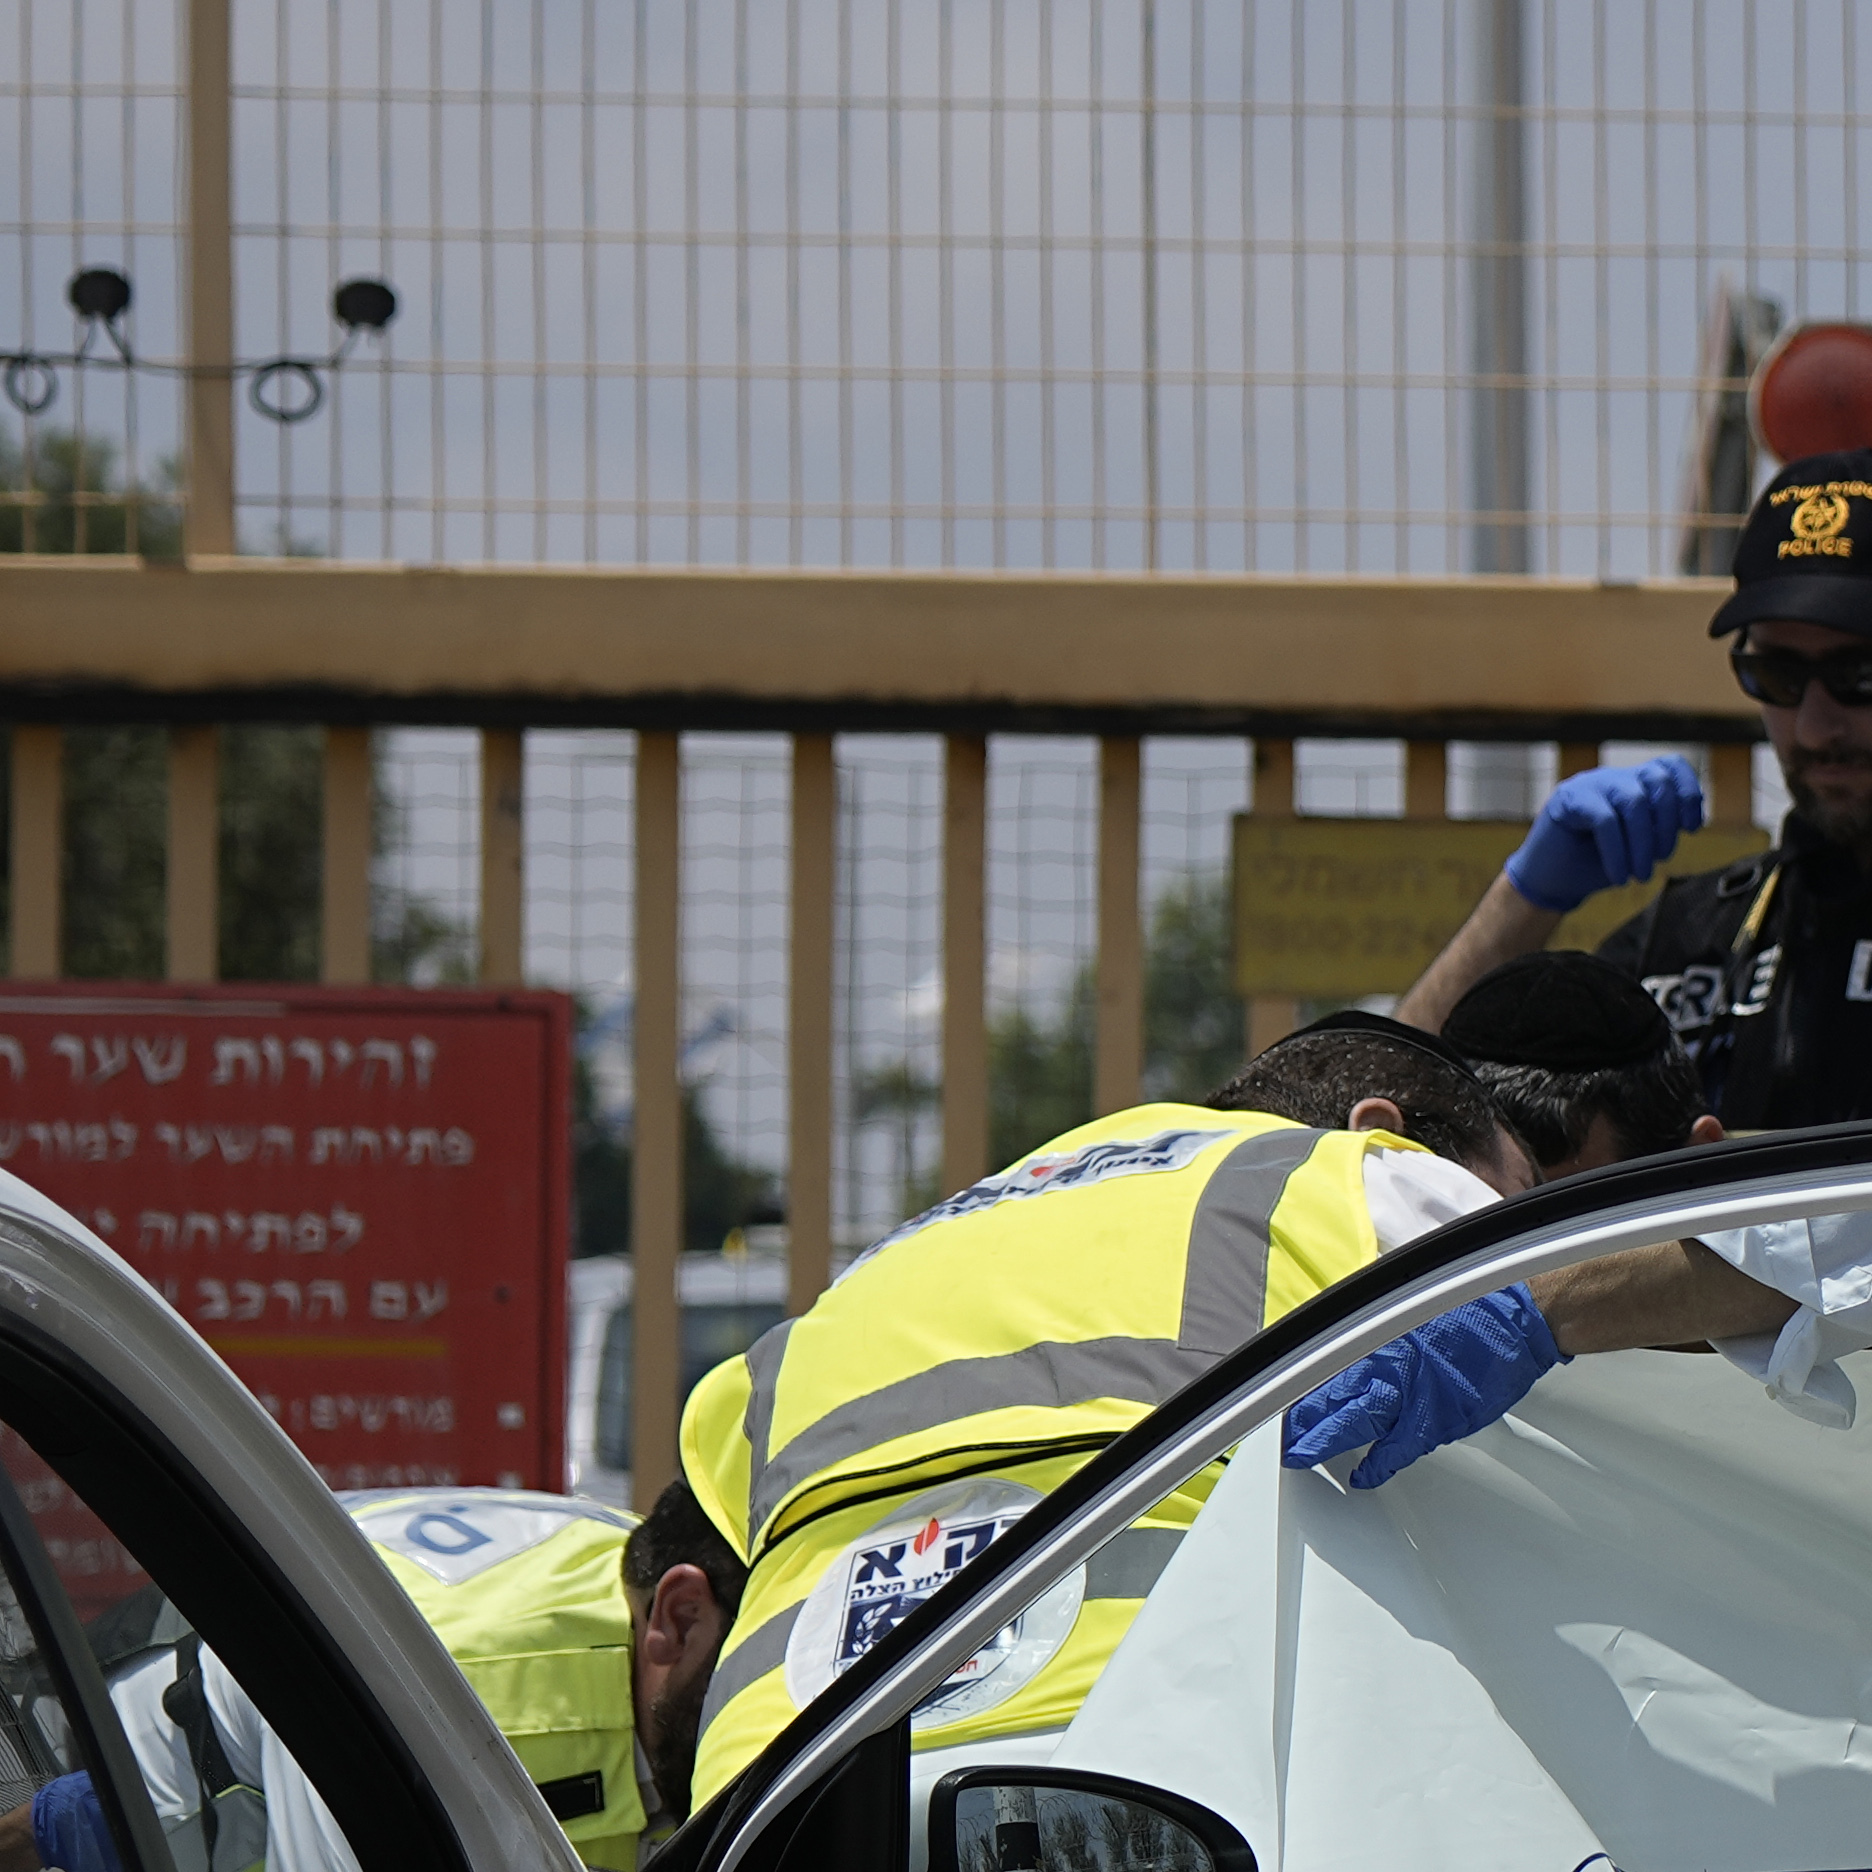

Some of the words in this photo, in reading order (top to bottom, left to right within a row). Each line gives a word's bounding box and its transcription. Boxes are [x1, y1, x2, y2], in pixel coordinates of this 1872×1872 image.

[1778, 536, 1855, 560] POLICE
[51, 1034, 188, 1088] שער
[211, 1034, 436, 1090] זהירות
[369, 1279, 448, 1323] עם
[850, 1581, 906, 1600] הצלה
